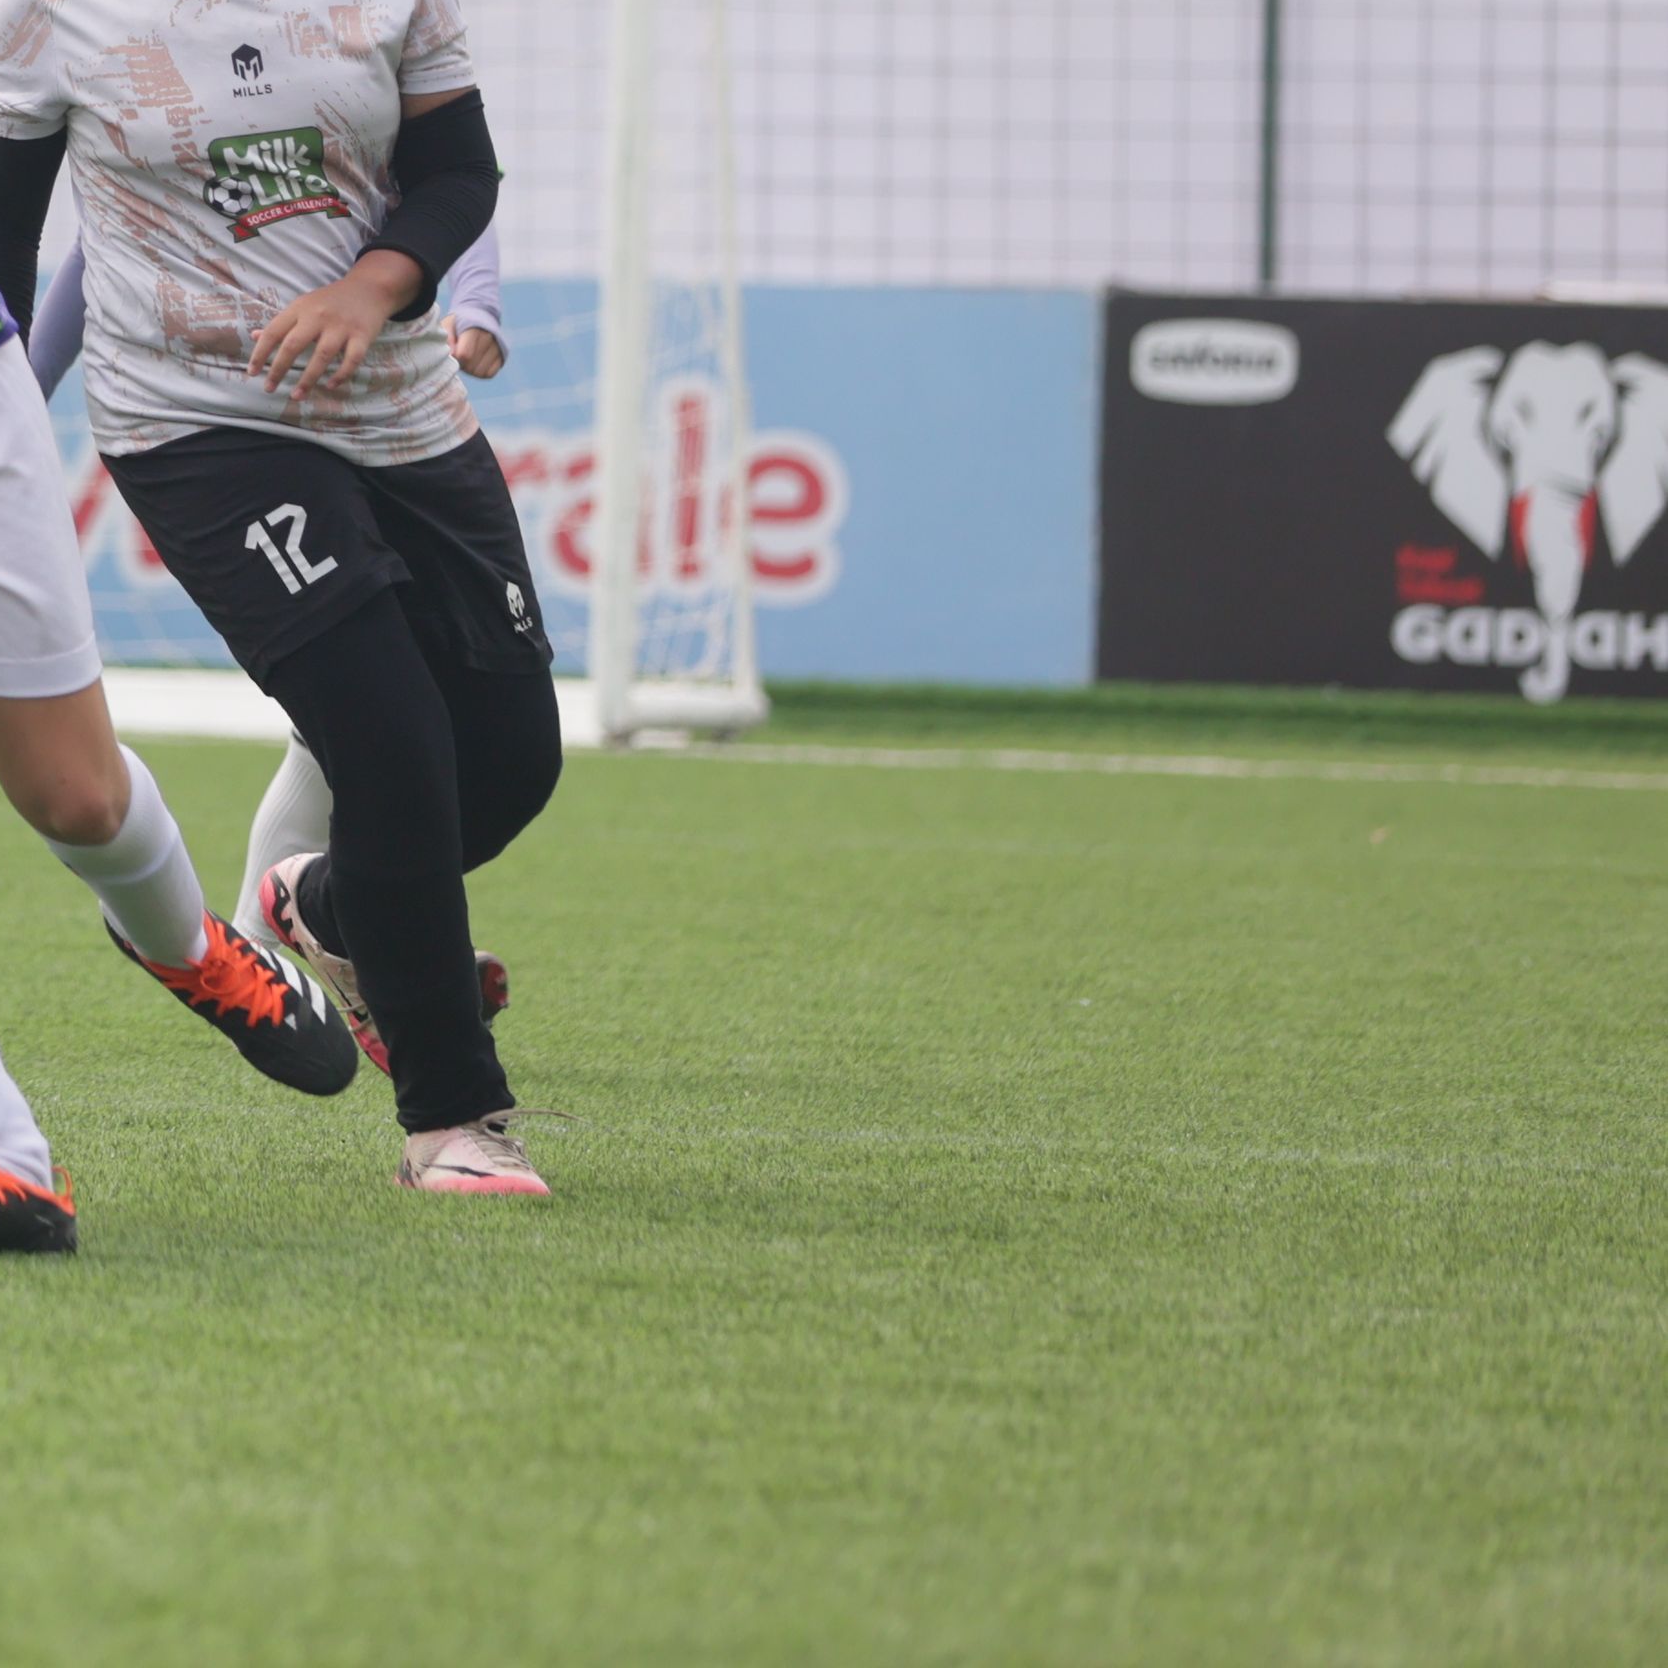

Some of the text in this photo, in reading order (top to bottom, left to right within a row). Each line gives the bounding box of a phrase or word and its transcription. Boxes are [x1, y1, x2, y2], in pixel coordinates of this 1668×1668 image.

[233, 84, 273, 98] MILLS
[223, 136, 312, 176] Milk
[247, 197, 334, 227] SOCCER CHALLENGE
[244, 502, 339, 595] 12
